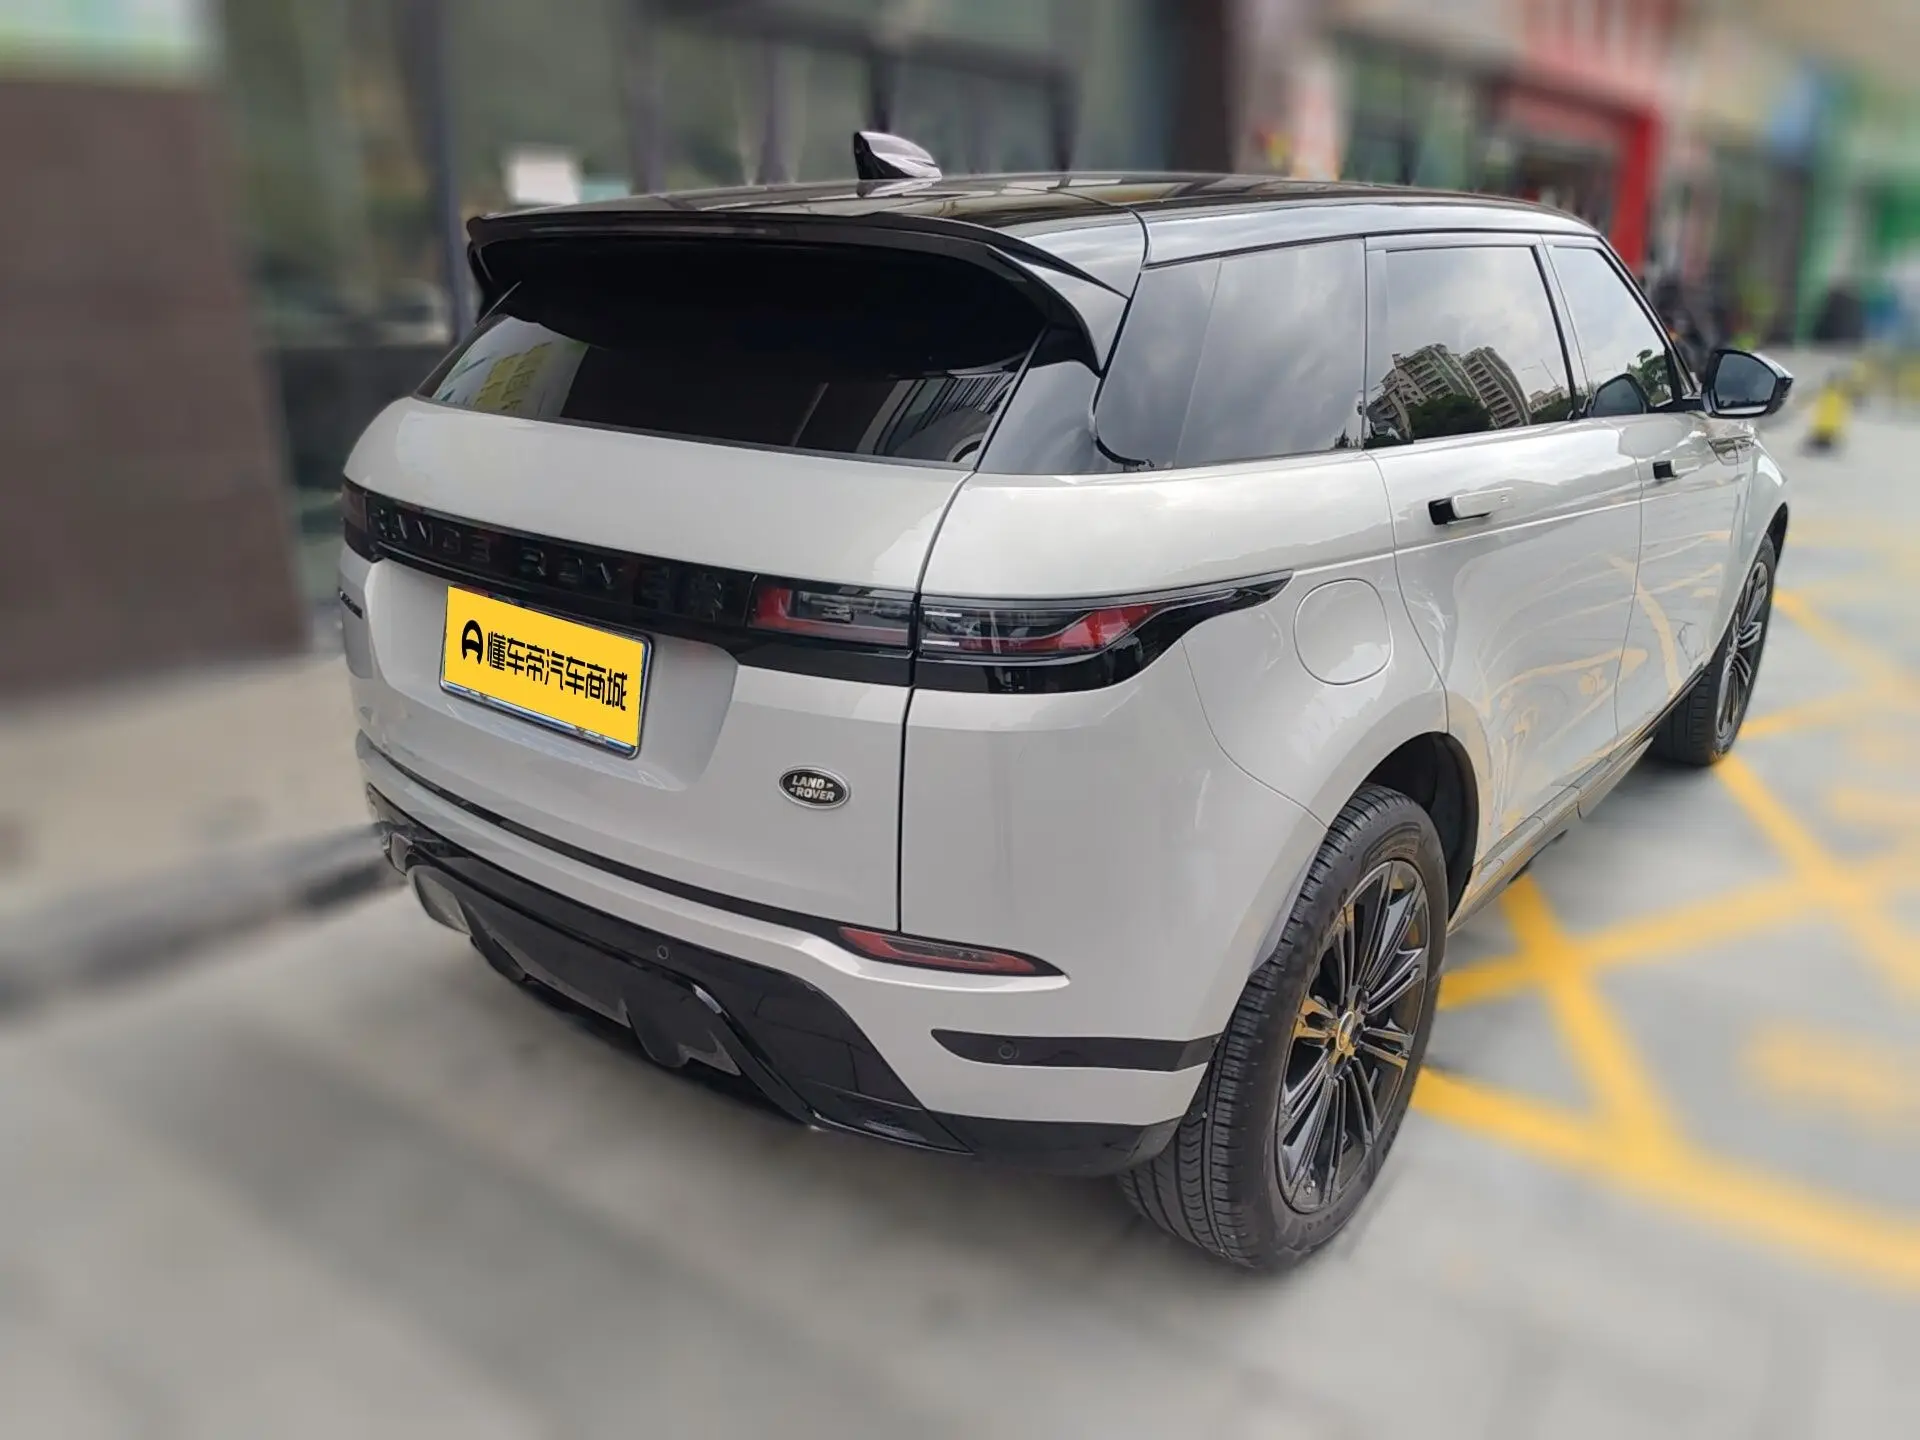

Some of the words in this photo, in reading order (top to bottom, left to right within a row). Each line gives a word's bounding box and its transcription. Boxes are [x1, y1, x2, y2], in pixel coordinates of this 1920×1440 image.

[370, 508, 492, 565] RANGE
[518, 545, 725, 624] ROVER
[792, 775, 826, 789] LAND
[795, 787, 836, 801] ROVER
